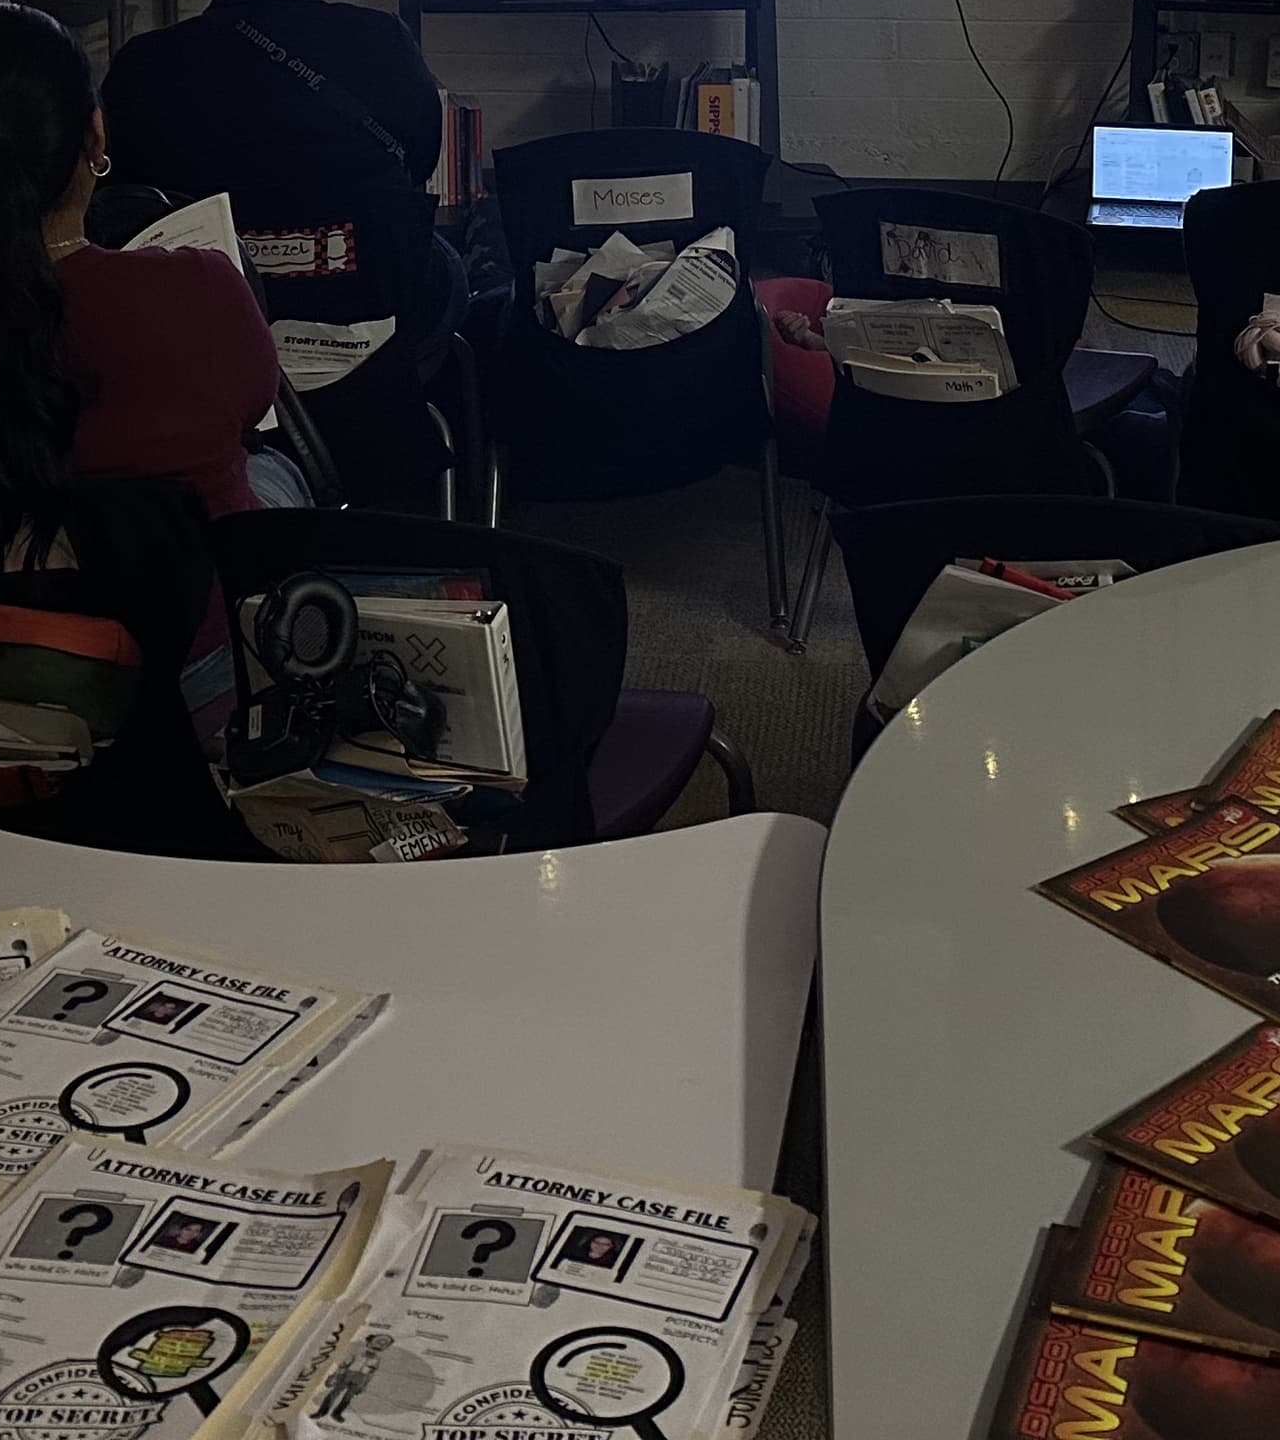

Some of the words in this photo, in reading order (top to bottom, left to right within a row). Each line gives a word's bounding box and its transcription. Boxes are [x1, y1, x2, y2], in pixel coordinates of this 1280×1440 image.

[592, 187, 665, 208] Moises
[284, 336, 318, 346] STORY
[320, 339, 370, 349] ELEMENTS
[945, 381, 973, 392] Math
[105, 947, 203, 977] ATTORNEY
[203, 972, 251, 990] CASE
[250, 984, 291, 1002] FILE
[95, 1158, 216, 1191] ATTORNEY
[220, 1180, 279, 1204] CASE
[281, 1190, 327, 1207] FILE
[487, 1171, 612, 1206] ATTORNEY
[616, 1196, 676, 1220] CASE
[681, 1206, 730, 1231] FILE
